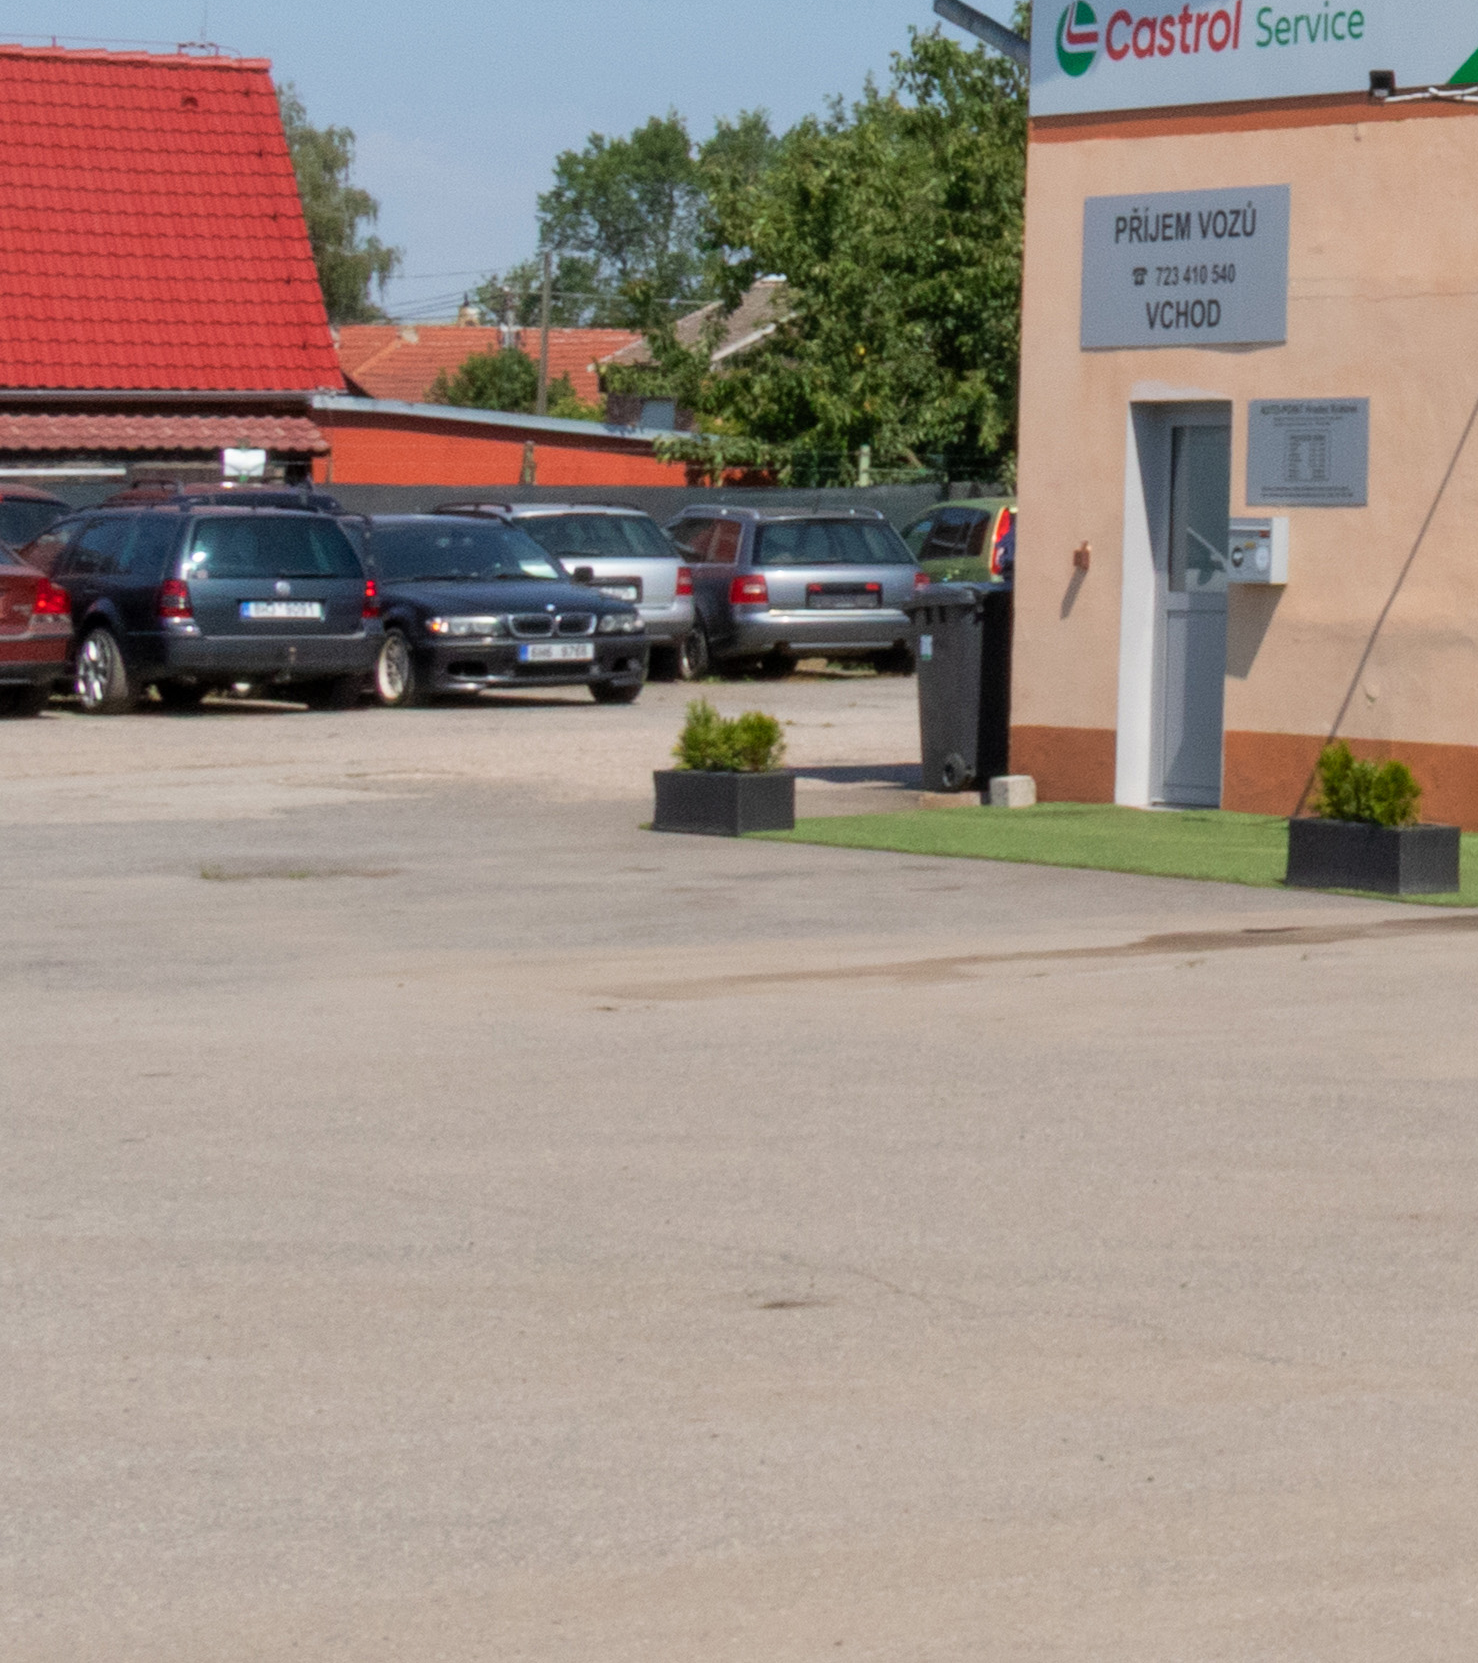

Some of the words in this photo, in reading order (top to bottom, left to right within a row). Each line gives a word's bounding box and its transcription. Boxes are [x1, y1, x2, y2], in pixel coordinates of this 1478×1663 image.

[1256, 1, 1365, 48] Service
[1114, 207, 1192, 244] PŘÍJEM
[1198, 201, 1257, 239] VOZŮ
[1156, 266, 1179, 286] 723
[1183, 265, 1207, 286] 410
[1211, 263, 1236, 284] 540
[1146, 299, 1222, 330] VCHOD
